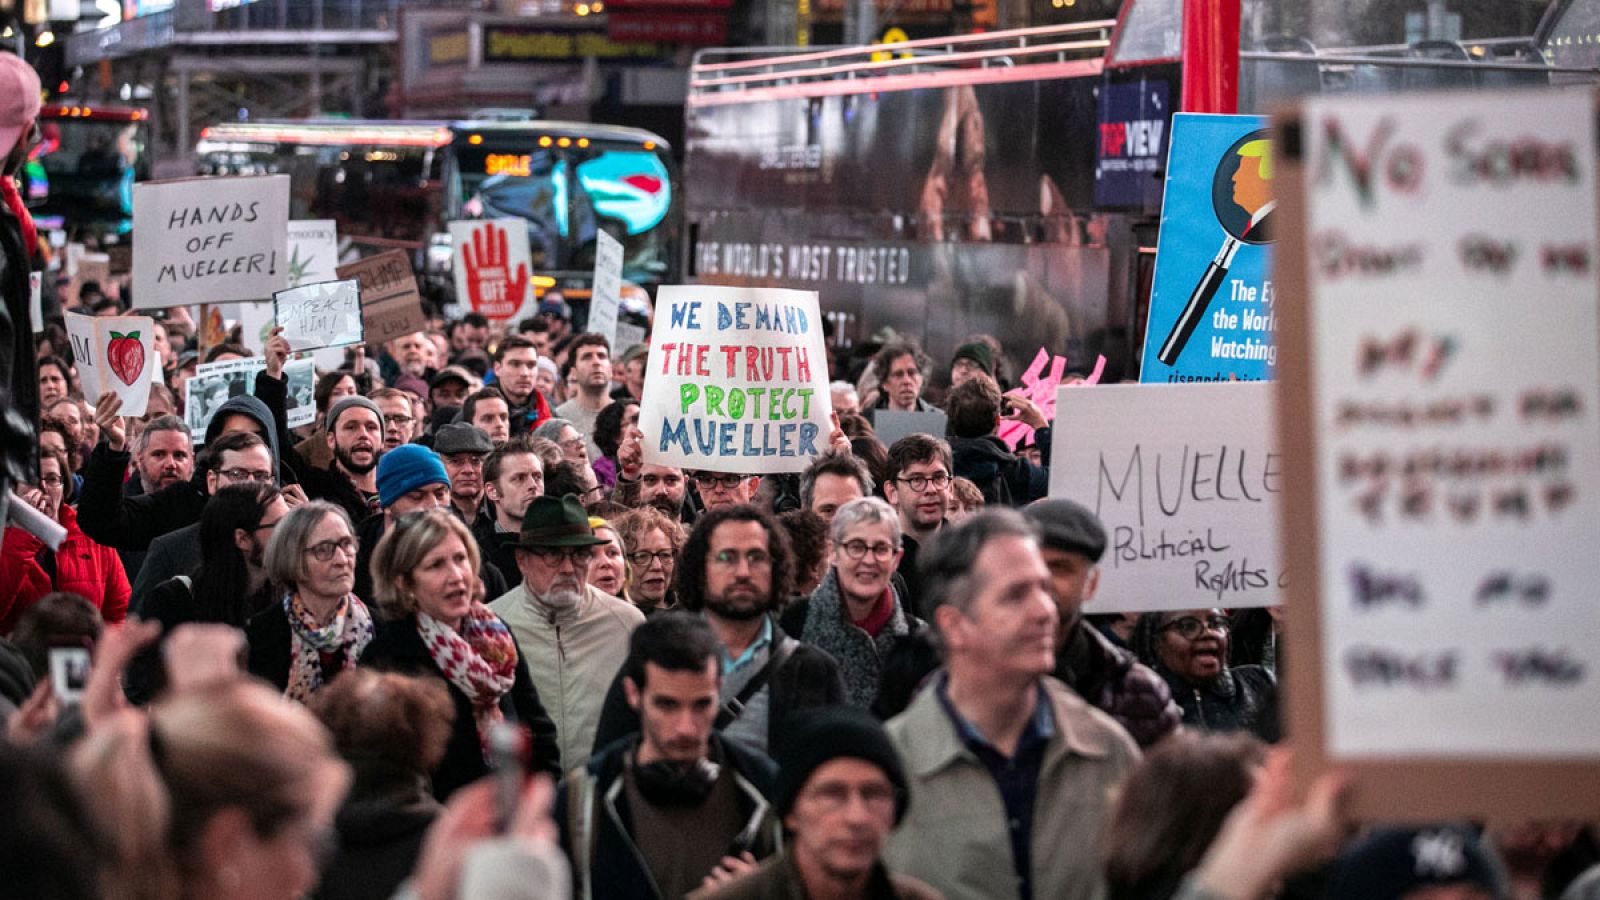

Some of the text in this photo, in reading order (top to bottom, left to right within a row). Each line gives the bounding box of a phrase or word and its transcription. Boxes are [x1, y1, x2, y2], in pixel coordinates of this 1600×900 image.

[168, 201, 260, 229] HANDS
[186, 232, 235, 253] OFF
[157, 250, 276, 283] MUELLER!
[723, 242, 784, 279] WORLD'S
[788, 245, 831, 281] MOST
[836, 246, 910, 285] TRUSTED
[1230, 279, 1257, 302] The
[671, 302, 702, 330] WE
[717, 302, 809, 335] DEMAND
[1213, 307, 1238, 329] the
[661, 342, 812, 383] THE TRUTH
[1211, 335, 1278, 366] Watching
[680, 382, 814, 421] PROTECT
[659, 416, 820, 458] MUELLER
[1095, 444, 1281, 527] MUELLE
